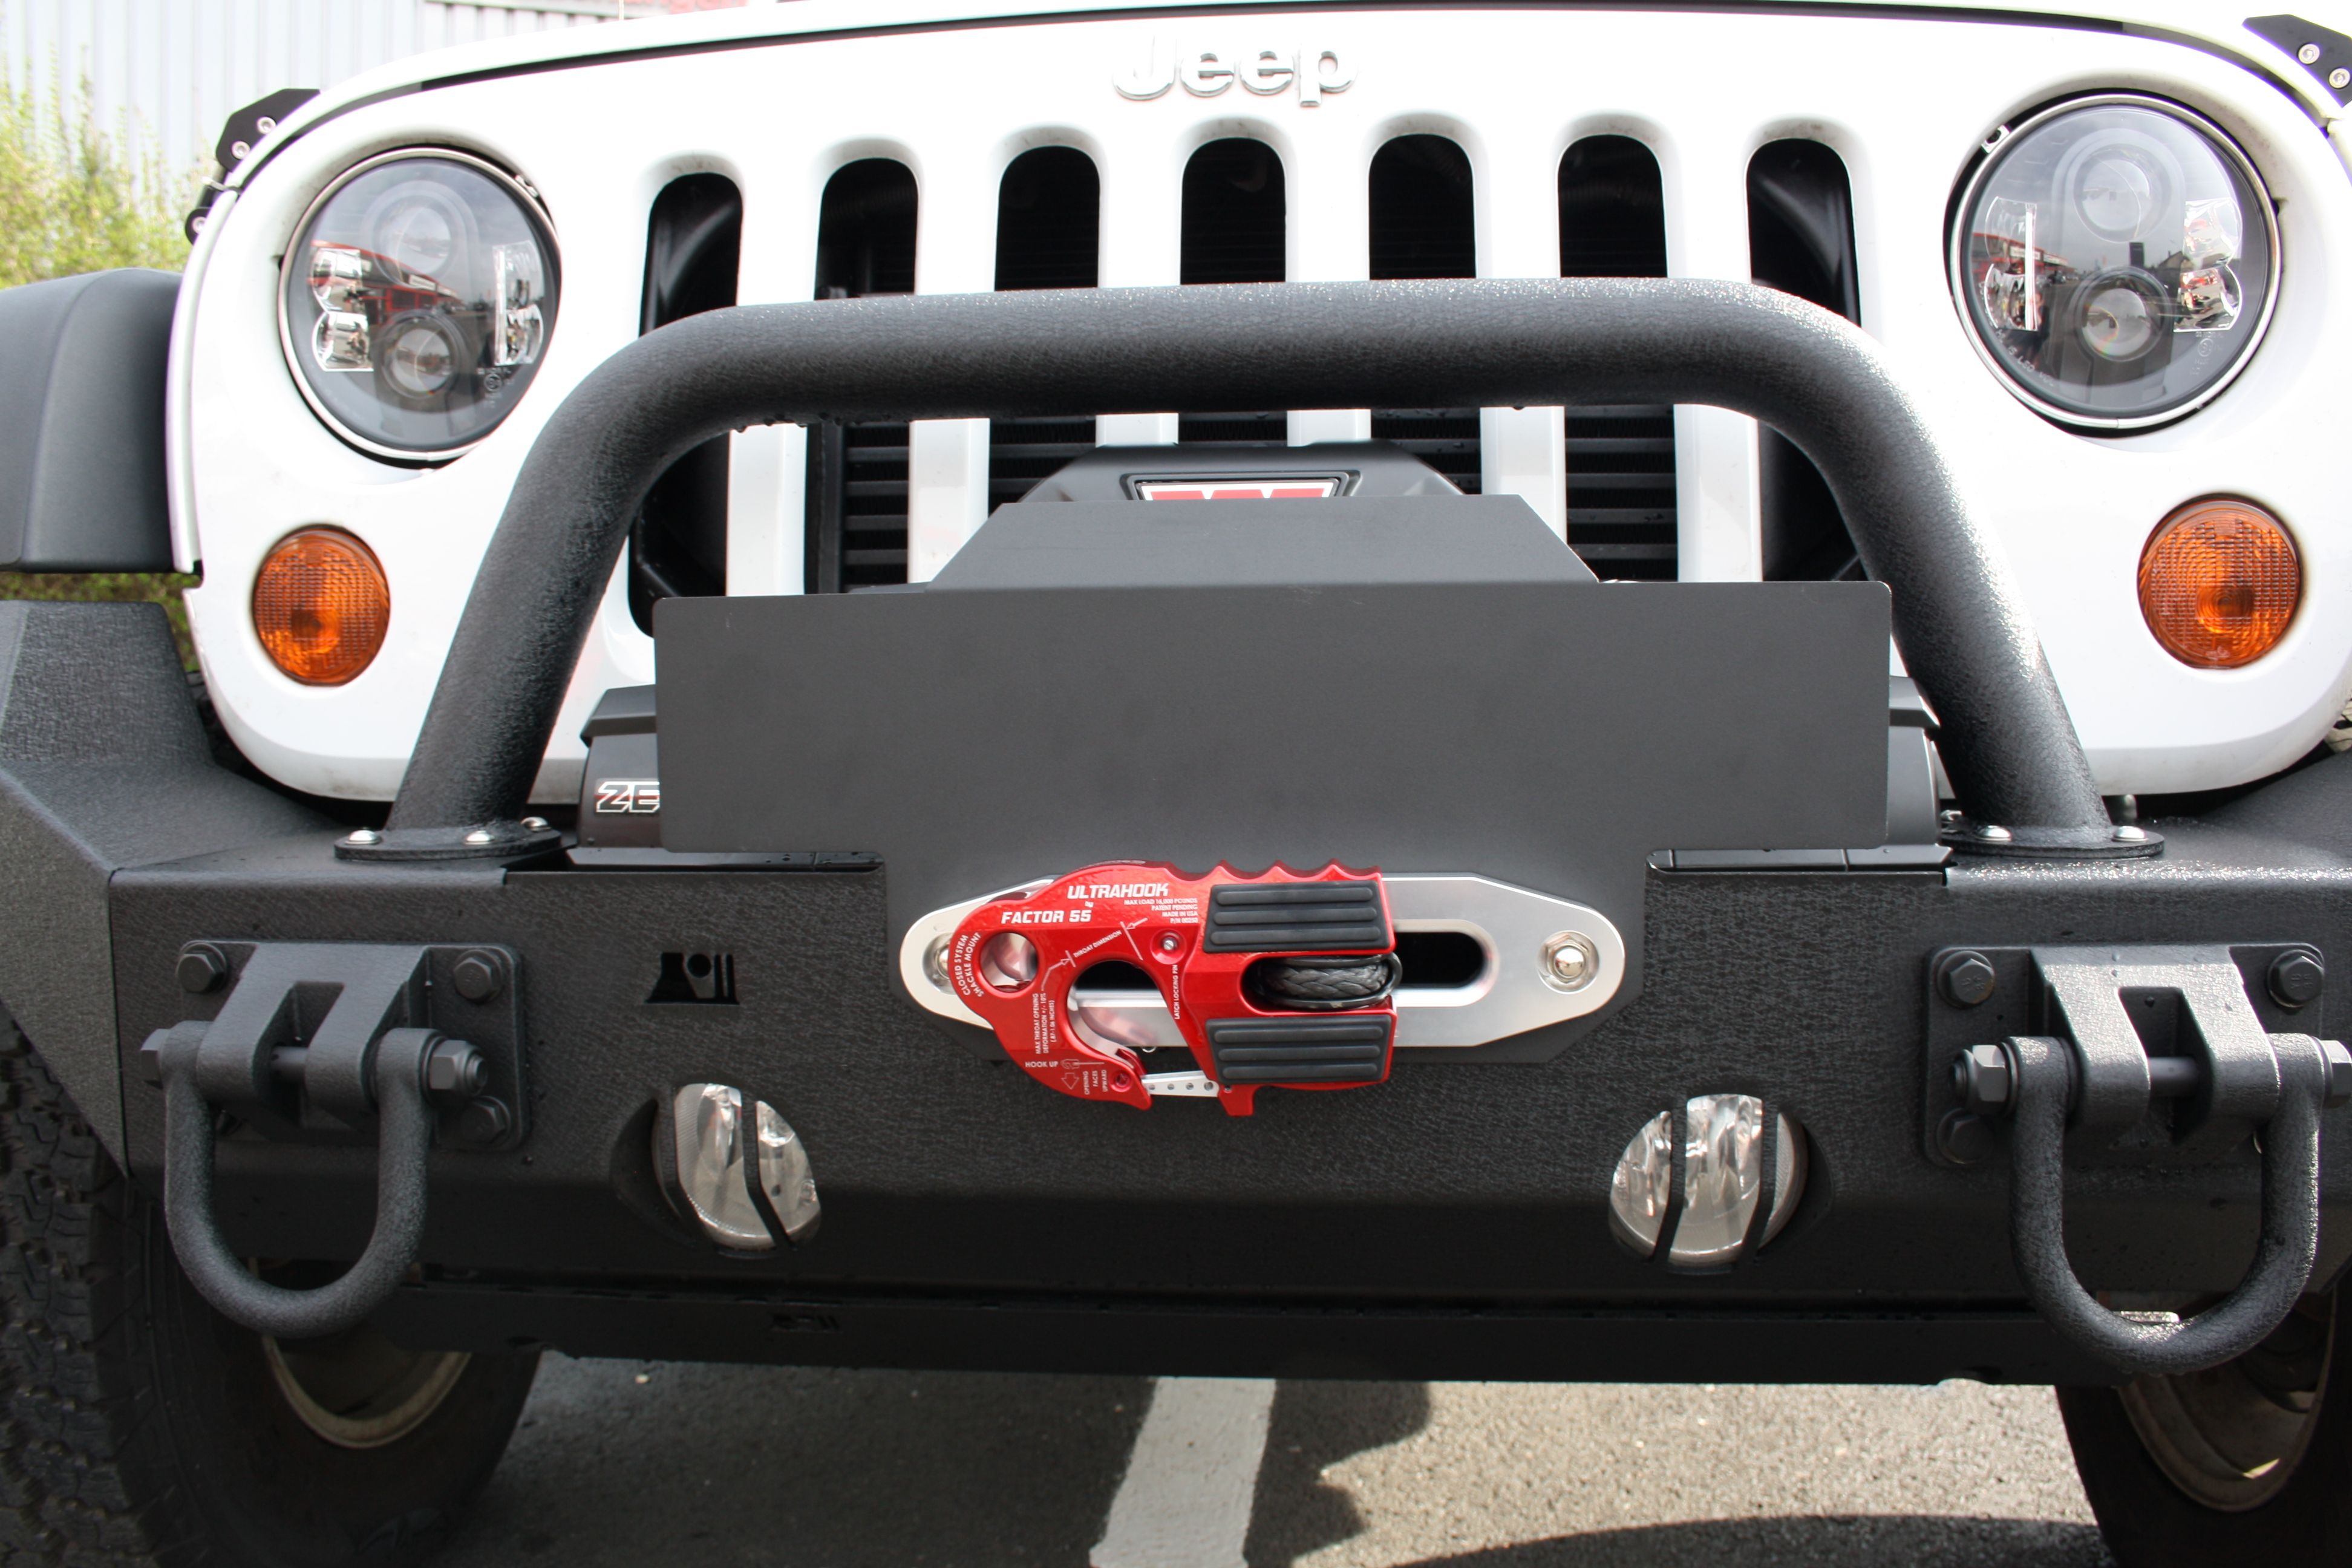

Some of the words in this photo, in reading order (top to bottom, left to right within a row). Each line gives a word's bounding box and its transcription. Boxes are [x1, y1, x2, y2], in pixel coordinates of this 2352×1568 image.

[1112, 33, 1357, 107] Jeep
[1067, 883, 1169, 899] ULTRAHOOK
[1001, 910, 1065, 924] FACTOR
[1069, 909, 1092, 923] 55
[954, 934, 969, 964] SYSTEM
[964, 932, 981, 962] MOUNT
[1073, 944, 1094, 958] THROAT
[1092, 930, 1122, 948] DIMENSION
[954, 965, 971, 996] CLOSED
[964, 962, 984, 997] SHACKLE
